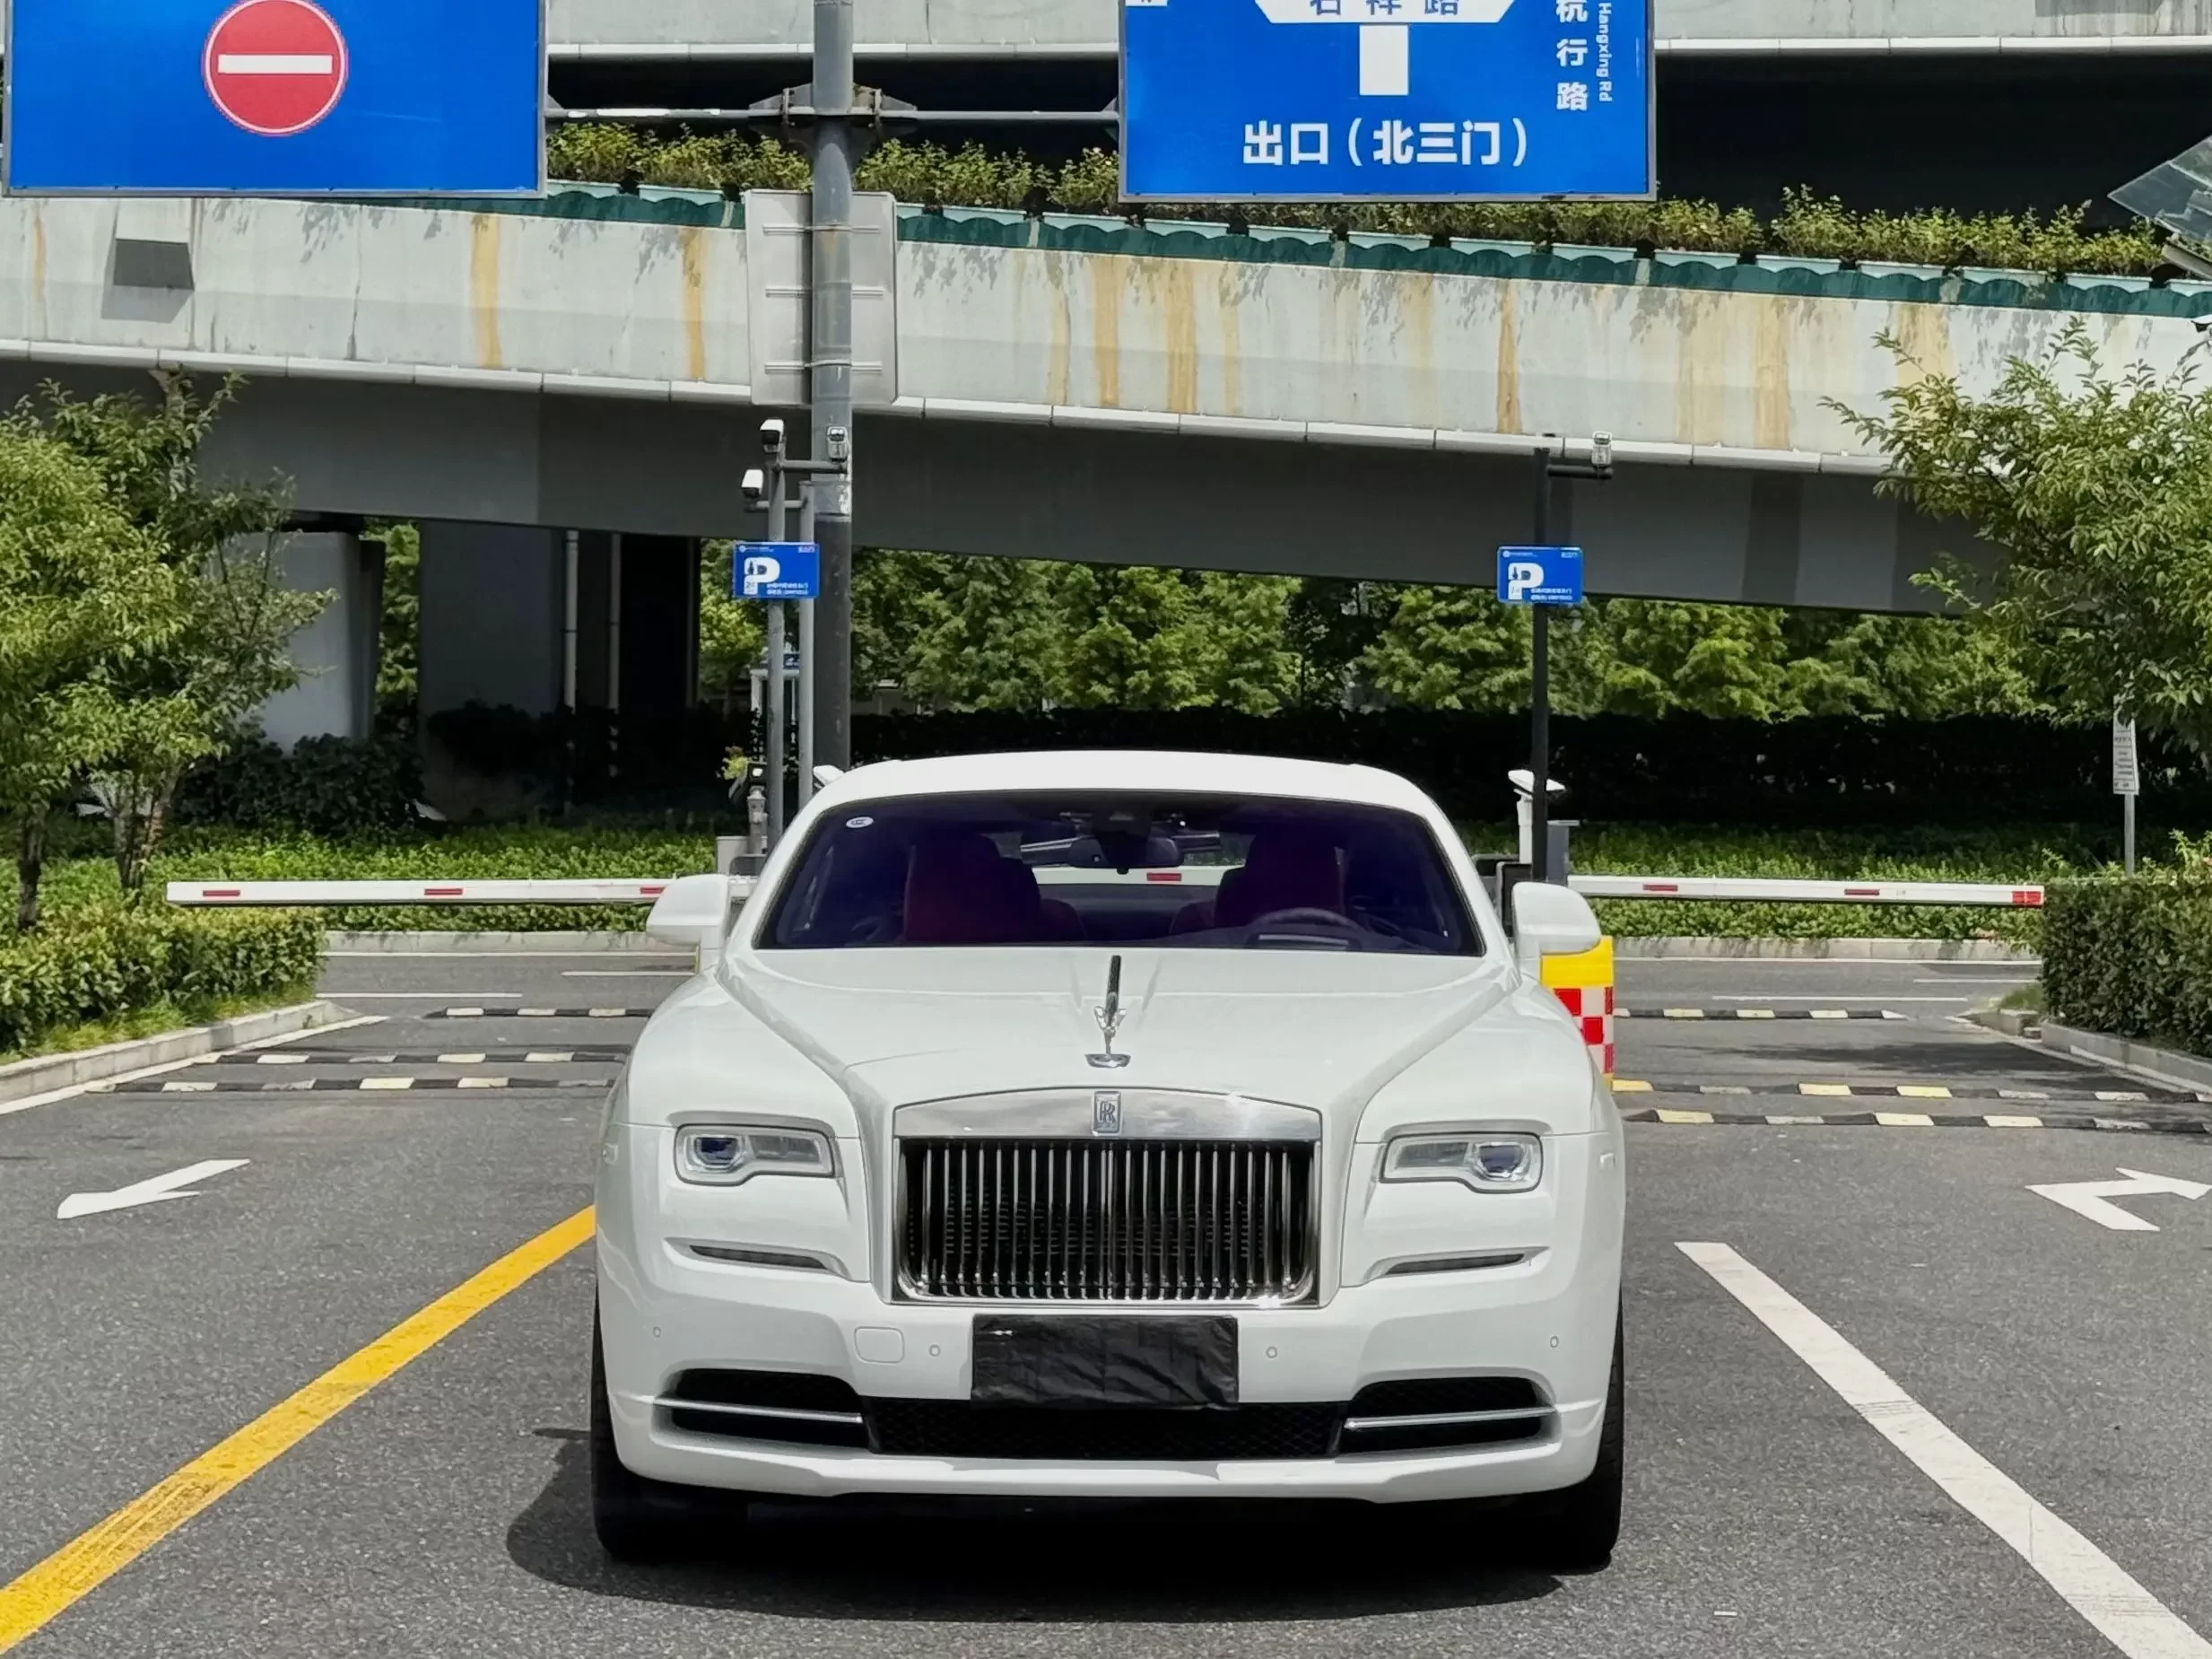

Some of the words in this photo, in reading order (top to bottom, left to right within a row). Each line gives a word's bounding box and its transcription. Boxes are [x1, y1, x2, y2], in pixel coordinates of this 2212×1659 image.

[1556, 0, 1588, 111] 杭行路
[1596, 3, 1612, 77] Hangxing
[1598, 81, 1613, 101] Rd
